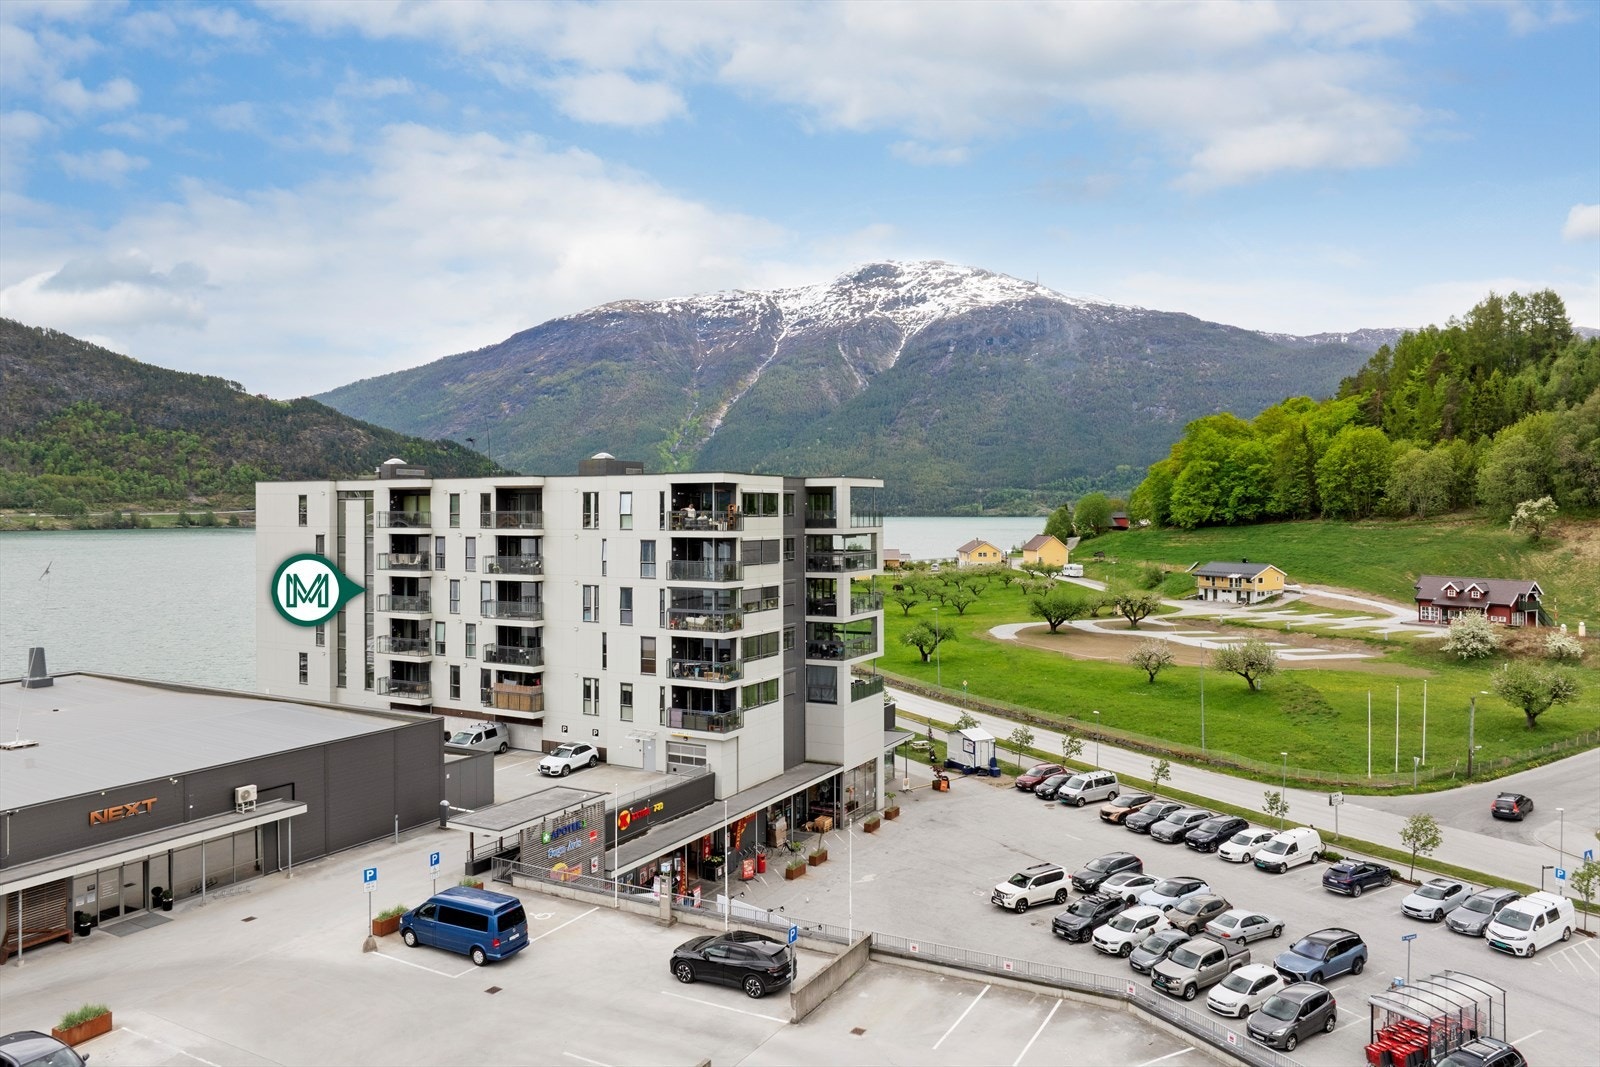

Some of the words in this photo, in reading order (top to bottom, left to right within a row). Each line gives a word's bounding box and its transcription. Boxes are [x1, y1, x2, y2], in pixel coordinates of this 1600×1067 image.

[89, 797, 158, 826] NEXT
[431, 854, 438, 864] P
[366, 869, 375, 881] P
[1557, 869, 1564, 878] P
[790, 928, 796, 942] P
